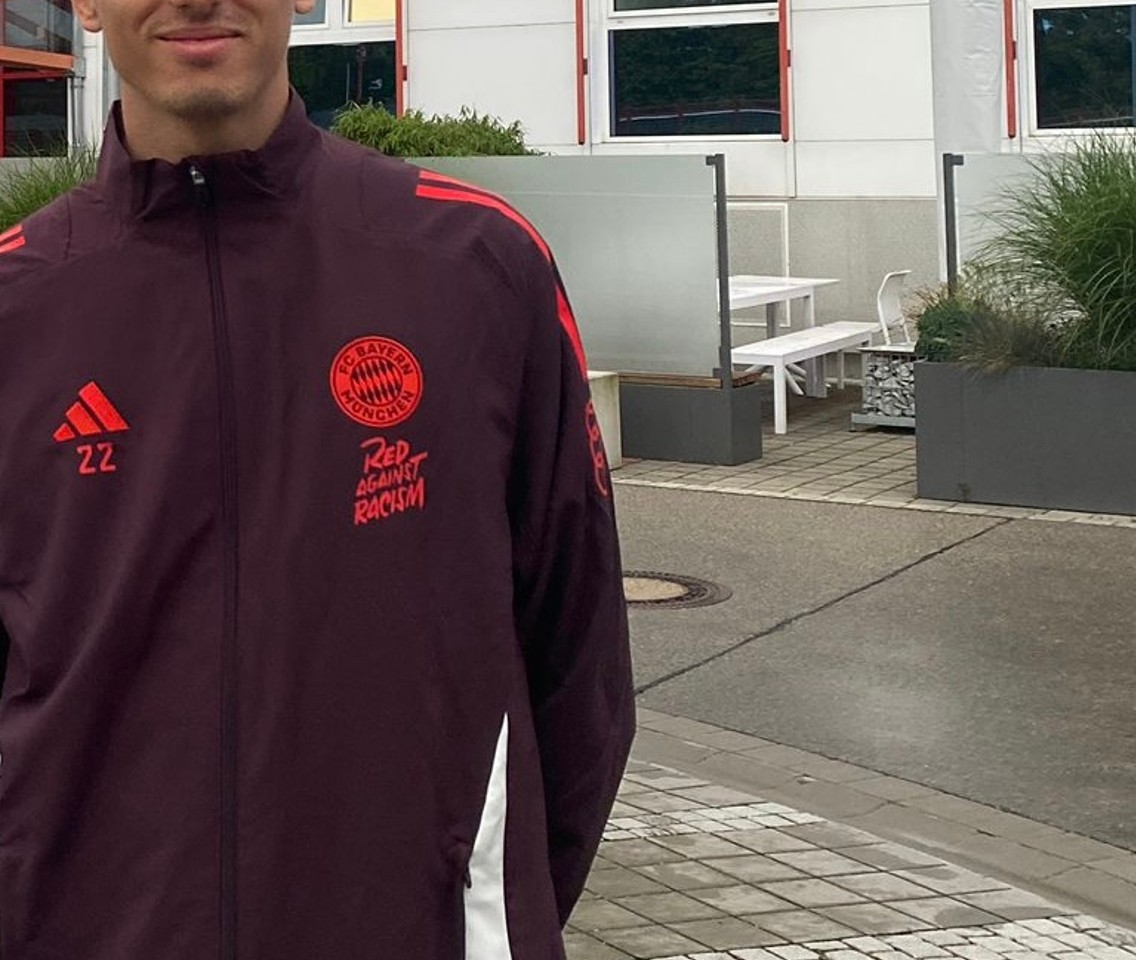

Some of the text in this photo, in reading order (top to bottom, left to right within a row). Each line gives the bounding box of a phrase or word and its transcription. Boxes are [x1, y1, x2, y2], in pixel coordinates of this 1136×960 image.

[339, 343, 413, 376] FC BAYERN
[77, 442, 116, 474] 22
[360, 437, 409, 473] RED
[356, 452, 428, 496] AGAINST
[354, 477, 424, 525] RACISM
